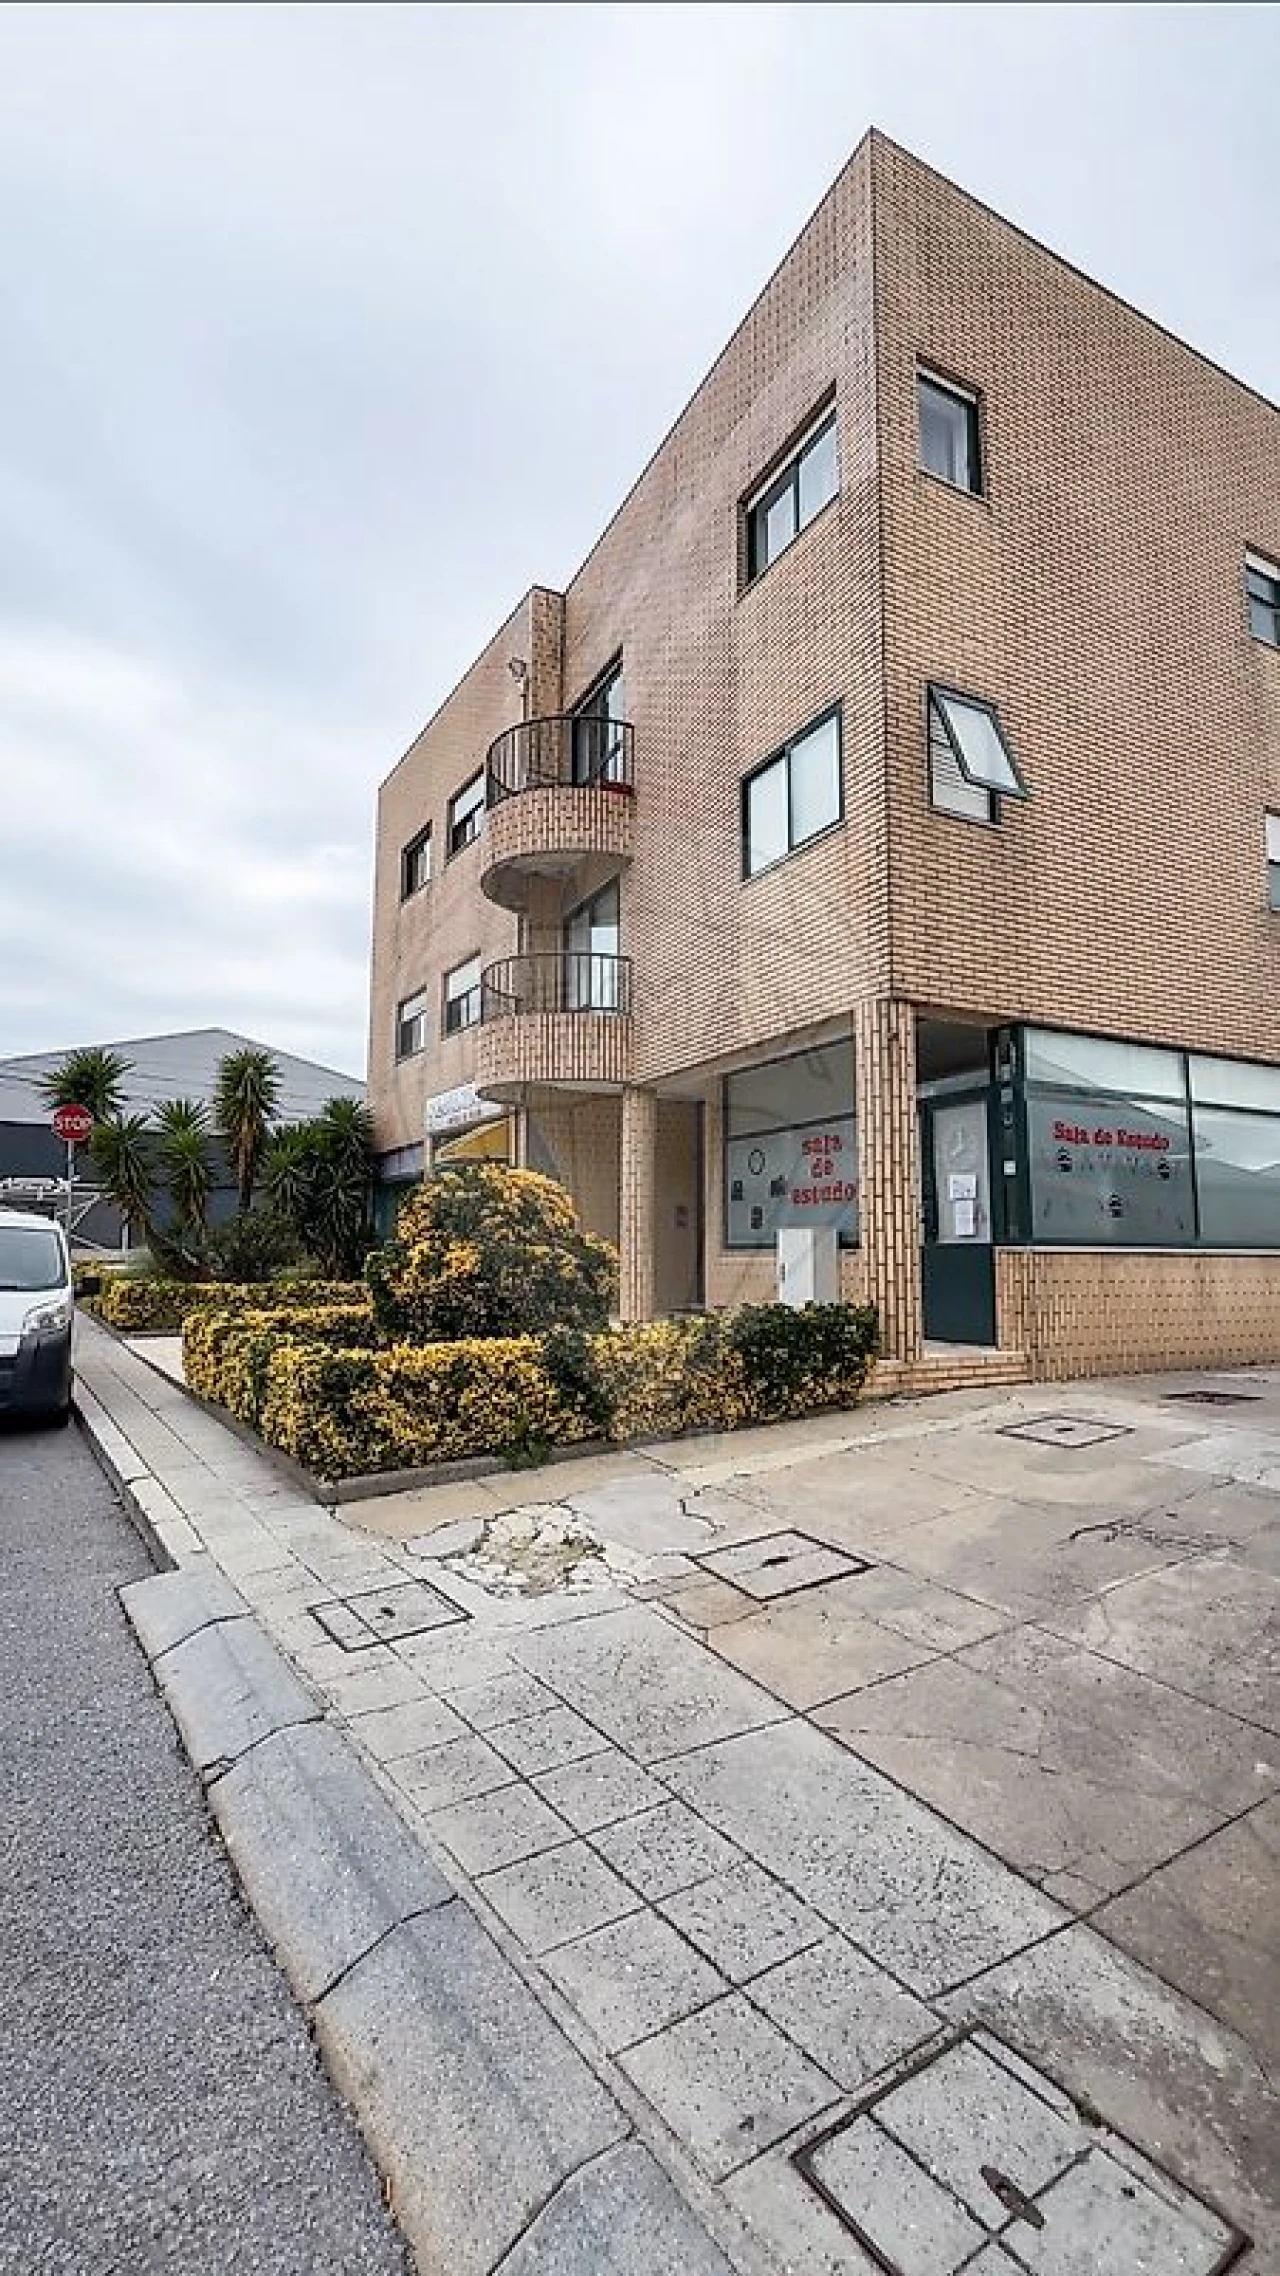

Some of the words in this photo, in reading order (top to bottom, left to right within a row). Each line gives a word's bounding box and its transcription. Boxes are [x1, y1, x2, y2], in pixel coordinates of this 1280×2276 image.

[54, 1115, 92, 1131] STOP
[1054, 1120, 1090, 1144] Sala
[1094, 1128, 1113, 1145] de
[811, 1157, 834, 1178] de
